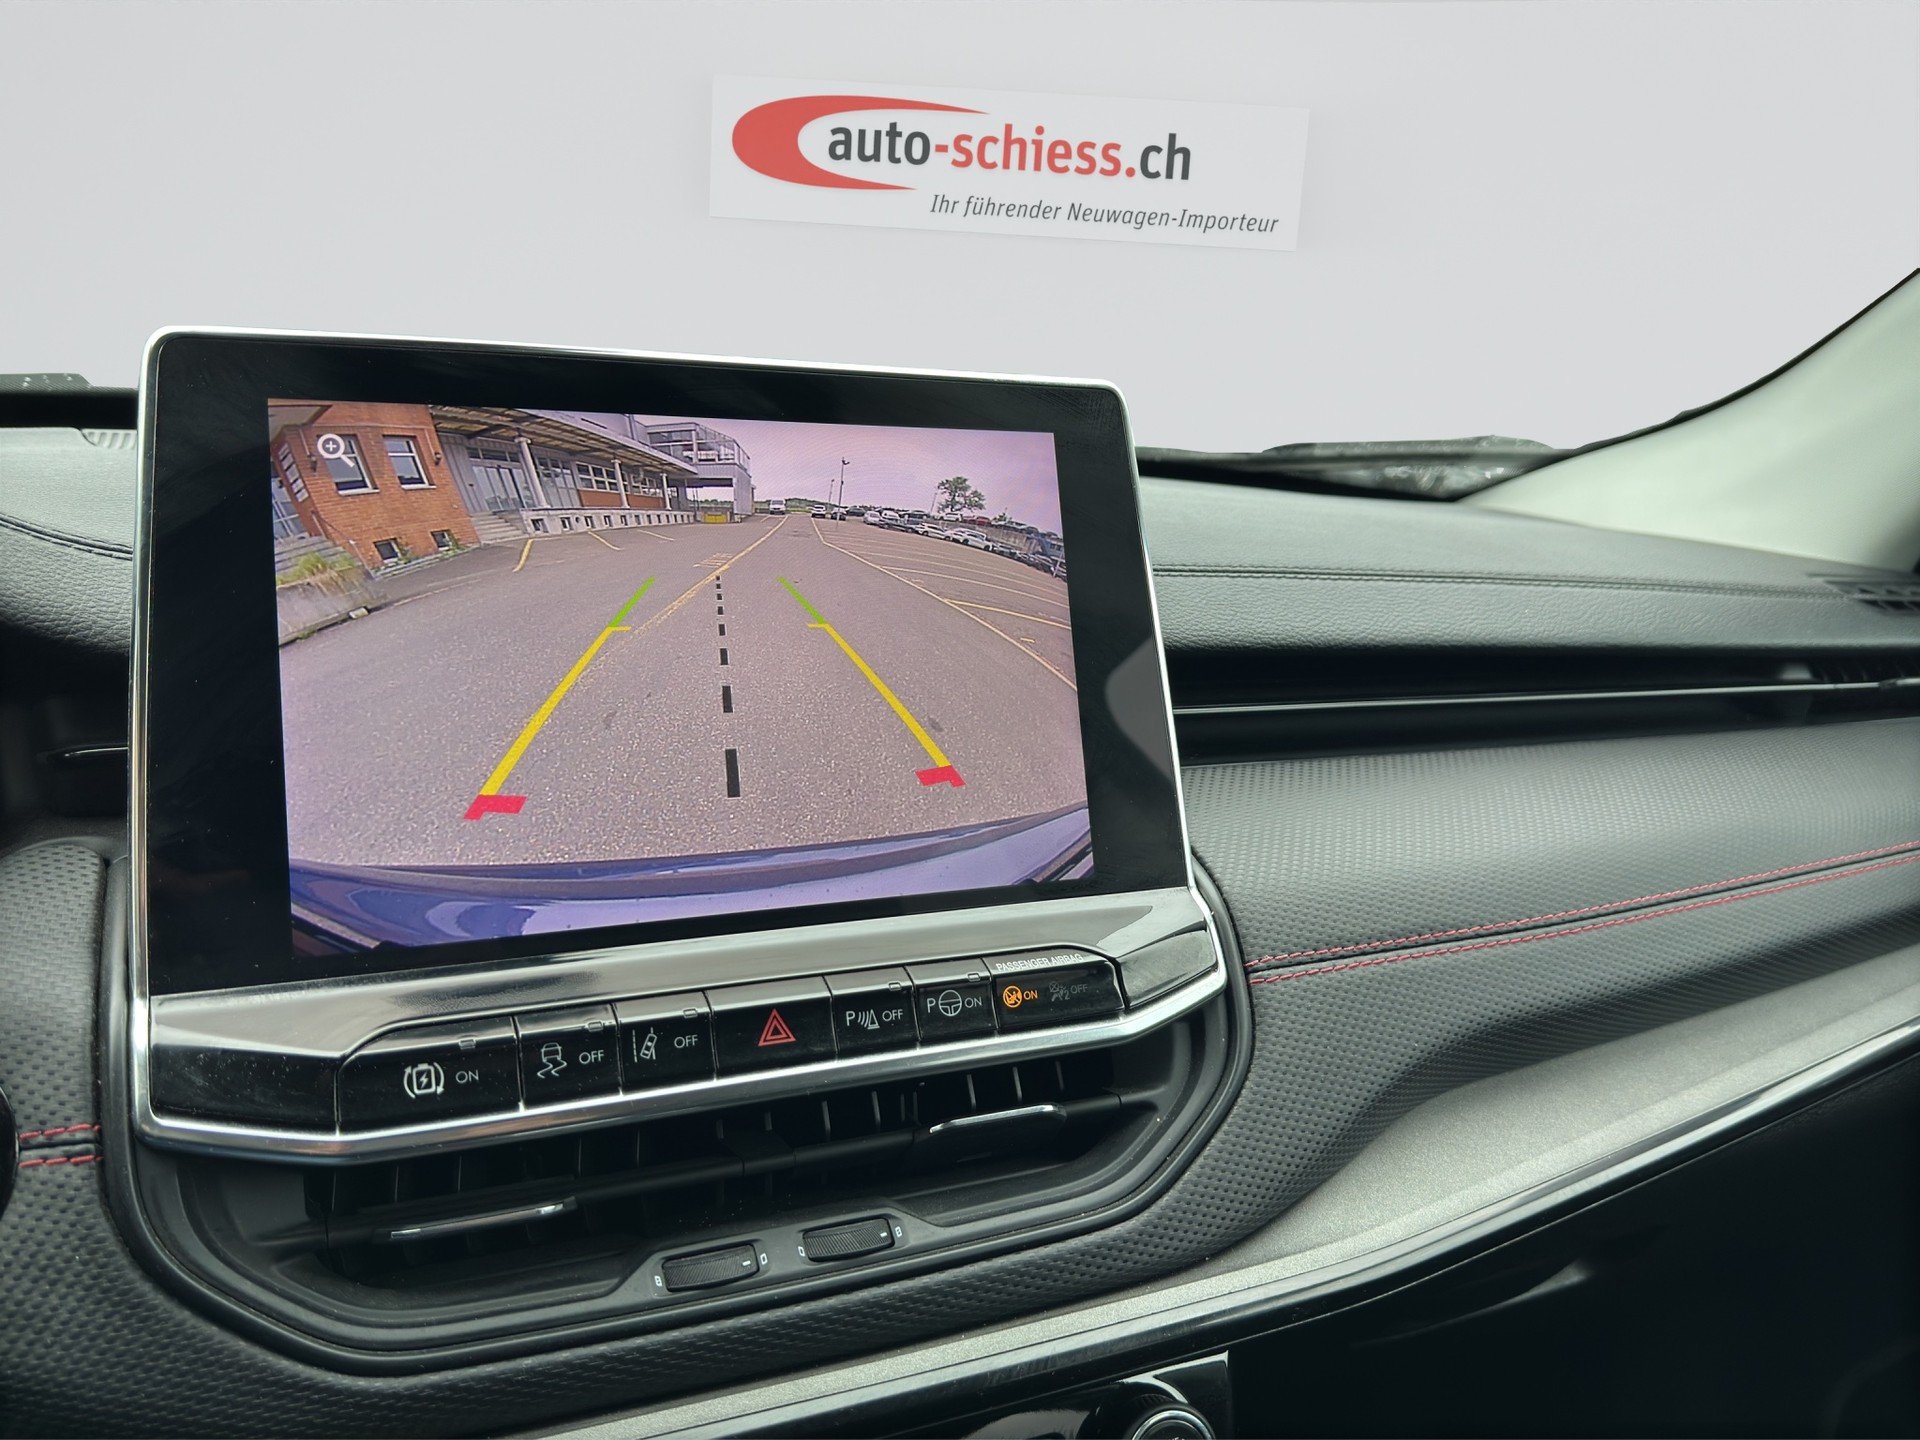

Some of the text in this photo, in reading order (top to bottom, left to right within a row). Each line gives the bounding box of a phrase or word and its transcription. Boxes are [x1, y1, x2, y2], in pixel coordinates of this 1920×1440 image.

[827, 121, 1192, 181] auto-schiess.ch
[930, 194, 1279, 234] Ihr führender Neuwagen-Importeur
[996, 953, 1083, 971] PASSENGER AIRBAG
[1023, 990, 1038, 1000] ON
[1070, 984, 1088, 994] OFF
[964, 997, 983, 1008] ON
[882, 1009, 904, 1021] OFF
[674, 1034, 699, 1048] OFF
[579, 1050, 604, 1064] OFF
[455, 1069, 479, 1084] ON
